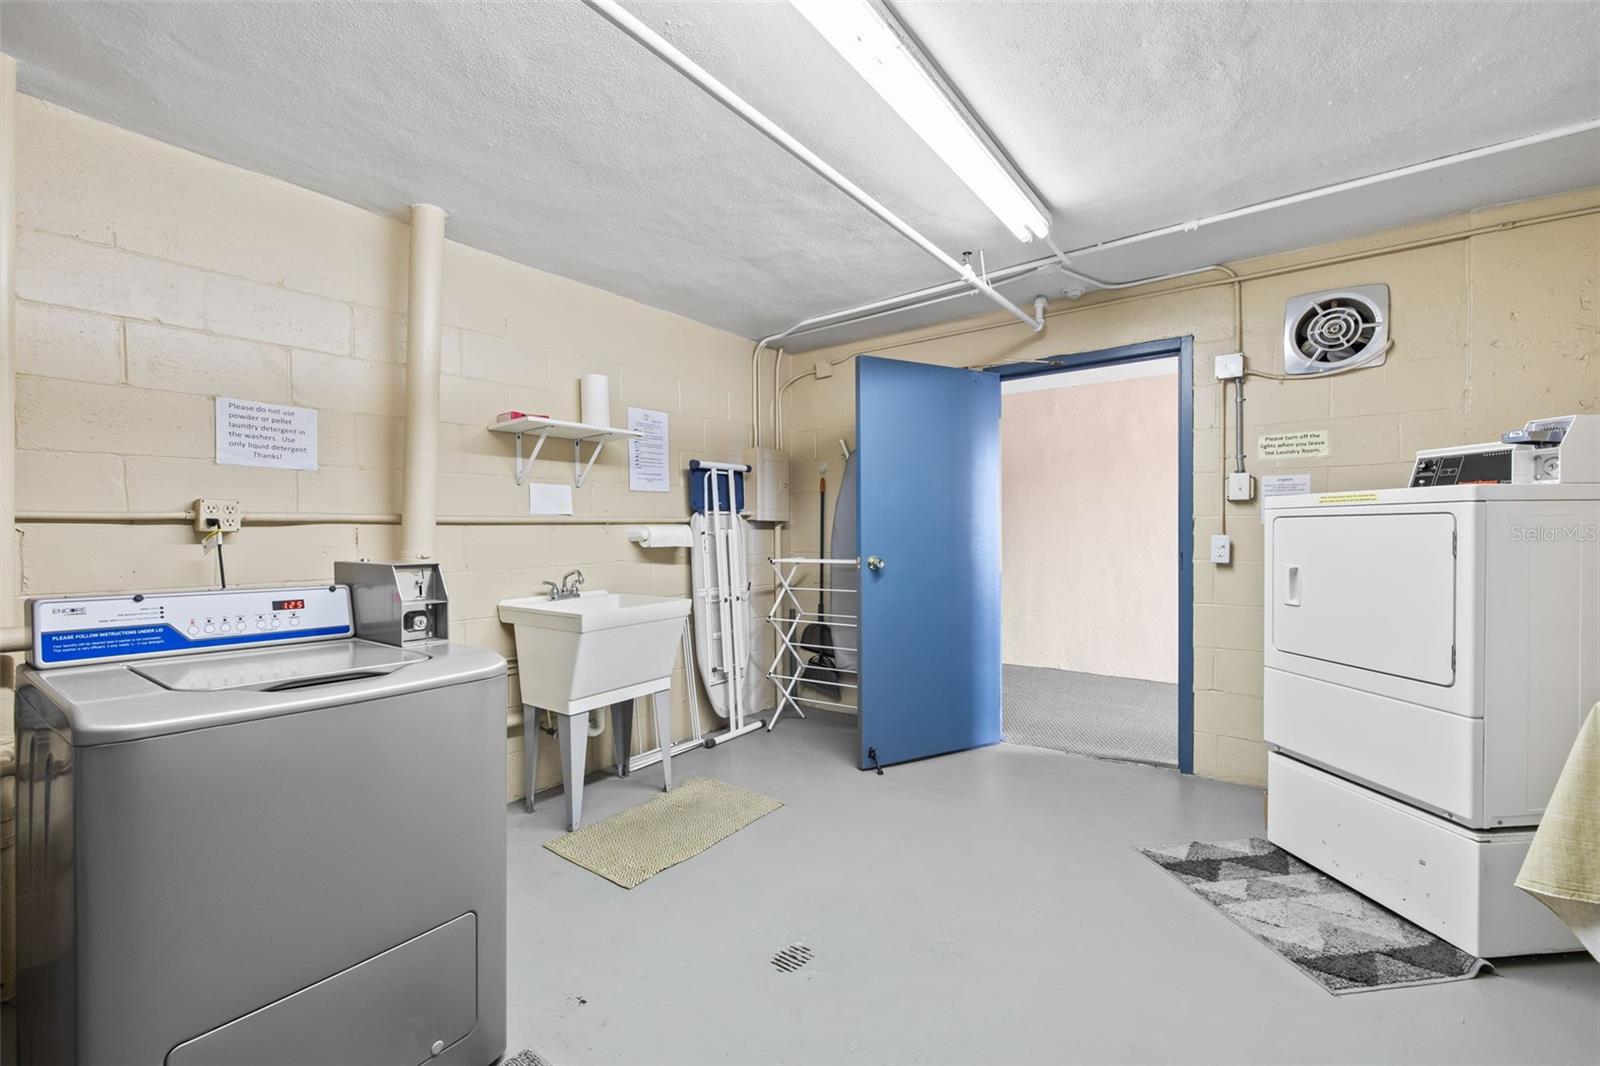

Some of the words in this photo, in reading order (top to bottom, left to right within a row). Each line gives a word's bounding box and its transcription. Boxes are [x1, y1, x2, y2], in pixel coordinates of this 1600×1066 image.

[228, 402, 254, 412] Please
[228, 413, 259, 421] powder
[271, 416, 292, 425] pellet
[228, 421, 259, 431] laundry
[260, 425, 297, 435] detergent
[244, 433, 278, 441] washers.
[247, 442, 270, 450] liquid
[271, 445, 309, 454] detergent.
[253, 451, 283, 460] Thanks!
[52, 606, 87, 614] ENCORE
